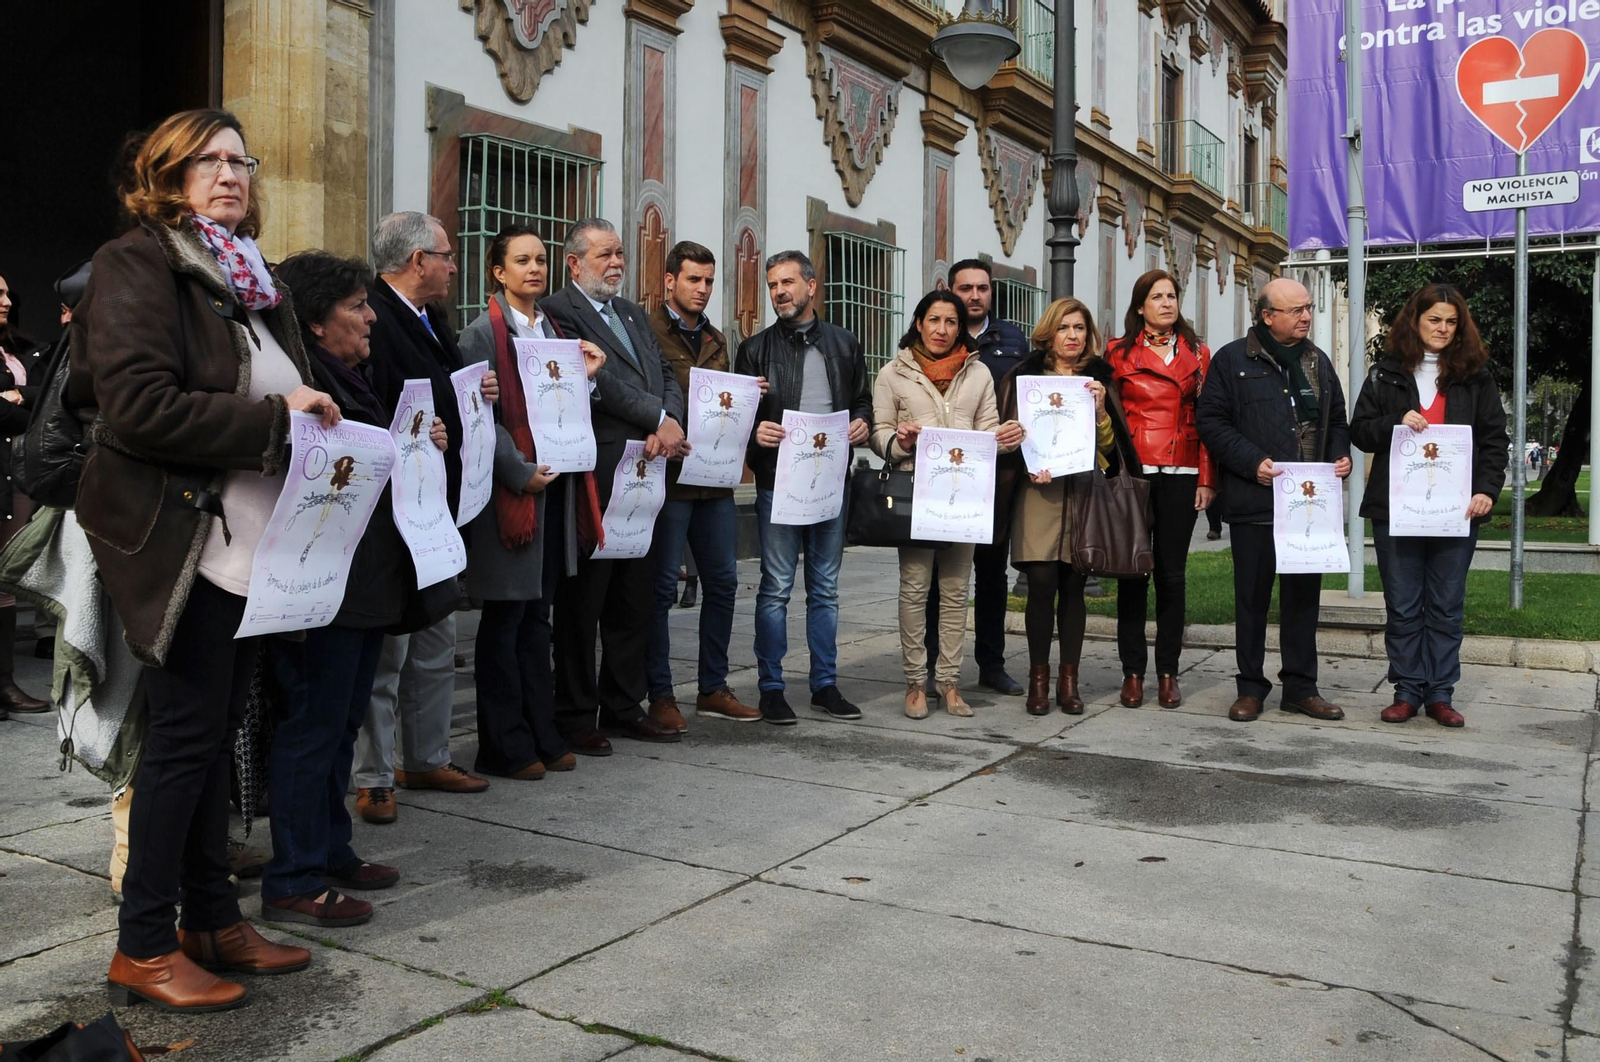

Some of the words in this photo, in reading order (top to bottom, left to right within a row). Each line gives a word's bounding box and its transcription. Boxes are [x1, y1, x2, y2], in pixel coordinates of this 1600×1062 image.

[1457, 11, 1503, 38] las
[1472, 183, 1493, 193] NO
[1497, 175, 1569, 190] VIOLENCIA
[1486, 190, 1554, 205] MACHISTA
[300, 423, 328, 444] 23N
[328, 427, 351, 441] PARO
[923, 432, 943, 442] 23N
